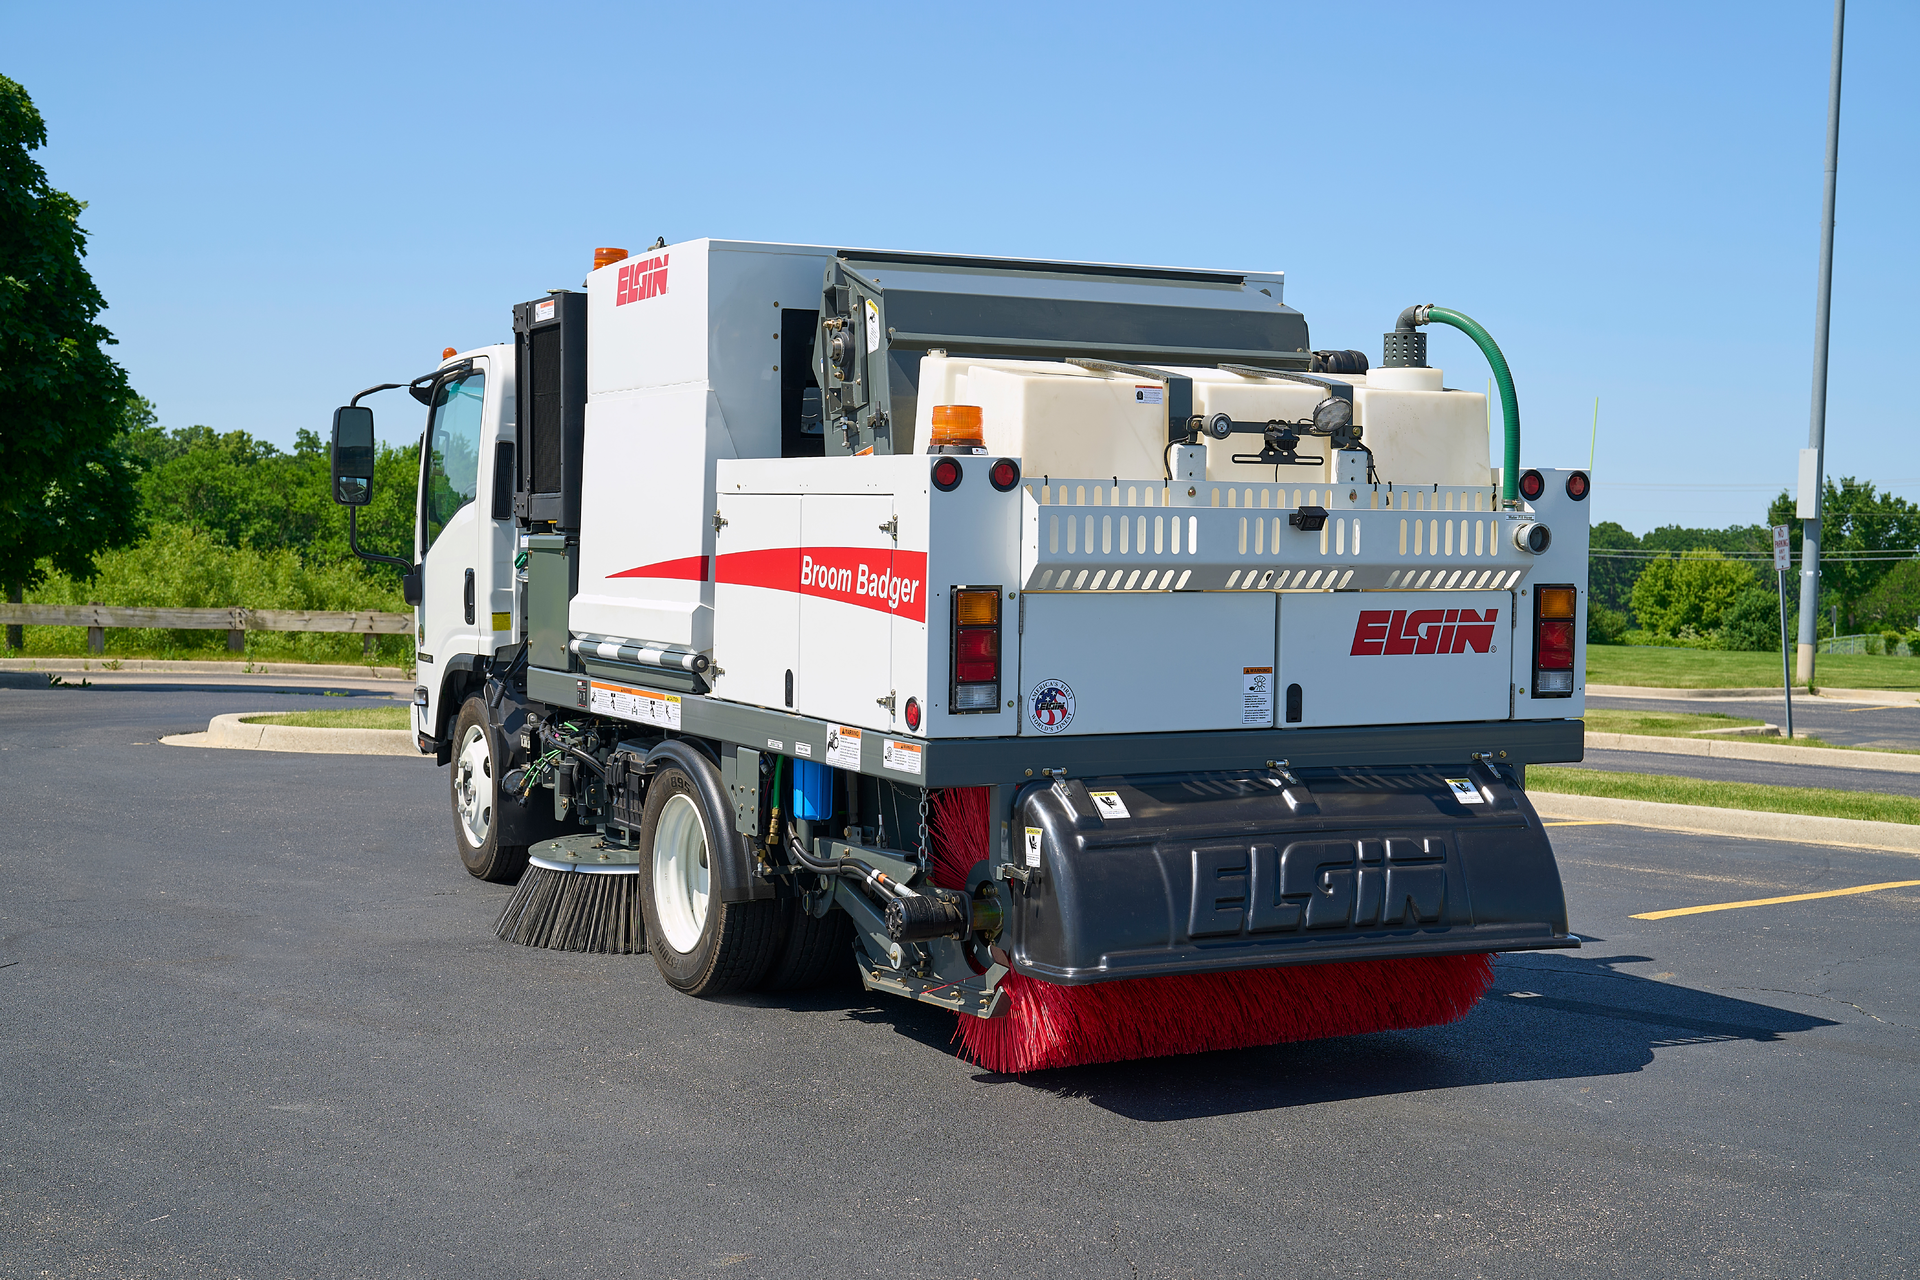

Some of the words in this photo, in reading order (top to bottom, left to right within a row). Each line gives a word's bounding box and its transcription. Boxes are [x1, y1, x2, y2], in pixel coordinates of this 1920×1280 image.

[616, 253, 669, 307] ELGIN
[1775, 539, 1789, 548] PARKING
[1778, 530, 1784, 538] NO
[801, 555, 852, 593] Broom
[856, 563, 920, 609] Badger
[1350, 608, 1499, 656] ELGIN
[1031, 681, 1059, 702] AMERICA'S
[1059, 684, 1073, 701] FIRST
[1040, 702, 1065, 710] ELGIN
[1031, 713, 1054, 732] WORLD'S
[1056, 713, 1072, 730] FINEST
[1188, 837, 1445, 938] ELGIN
